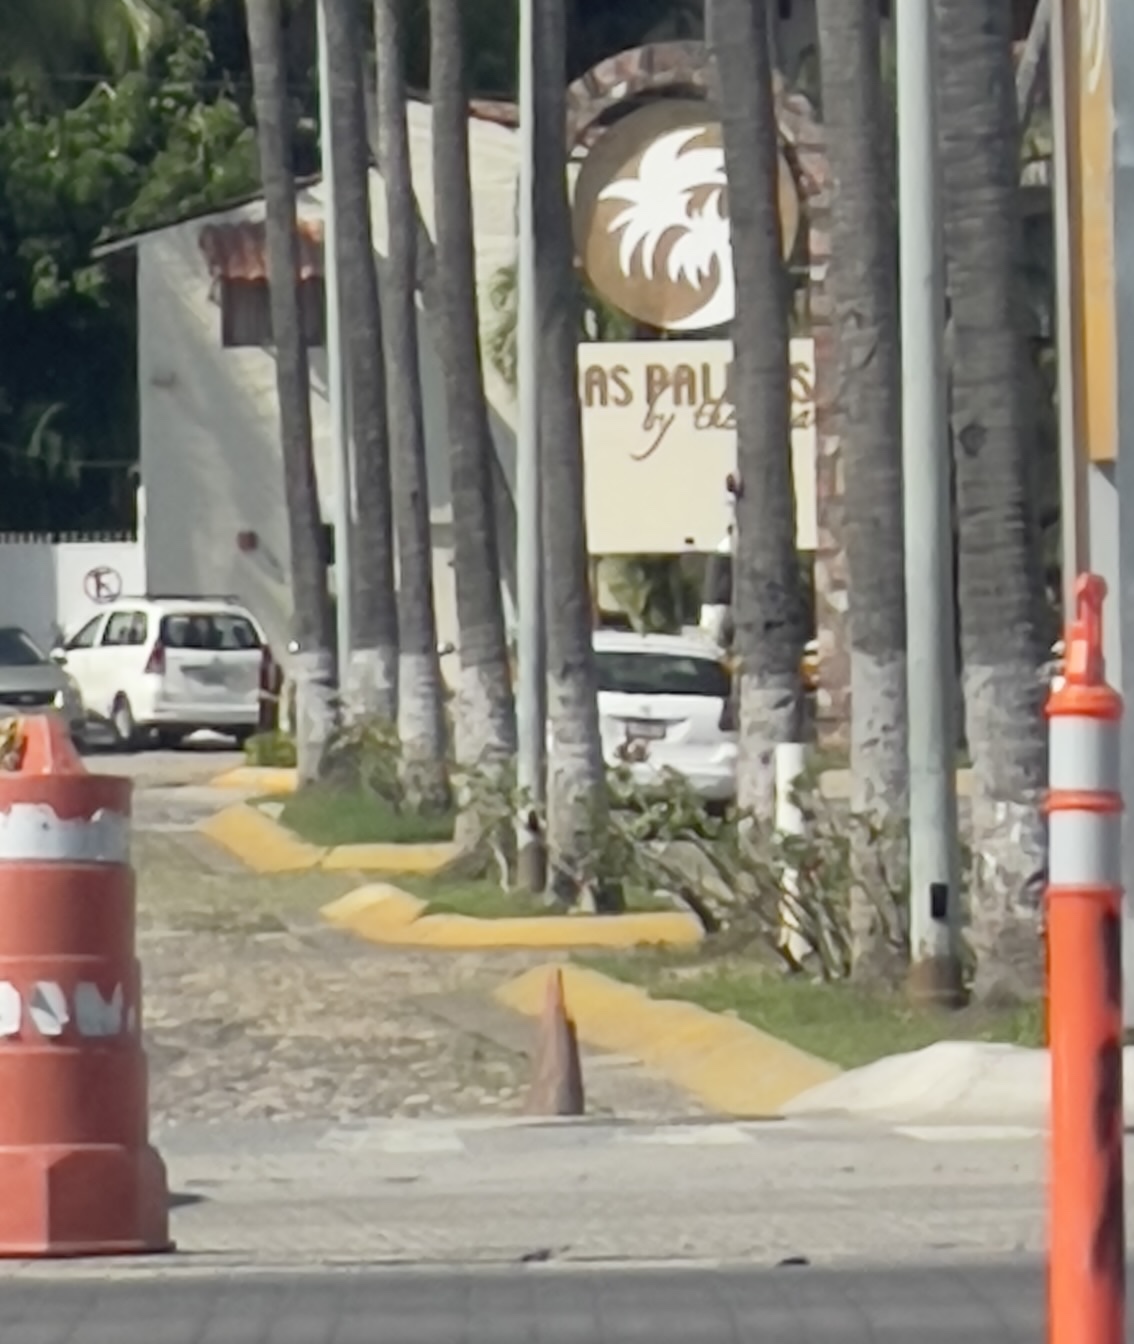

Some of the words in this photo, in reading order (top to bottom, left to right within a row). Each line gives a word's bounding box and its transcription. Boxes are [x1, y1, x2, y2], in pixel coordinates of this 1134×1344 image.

[584, 363, 633, 408] AS
[645, 362, 814, 408] PALS
[630, 382, 676, 462] by
